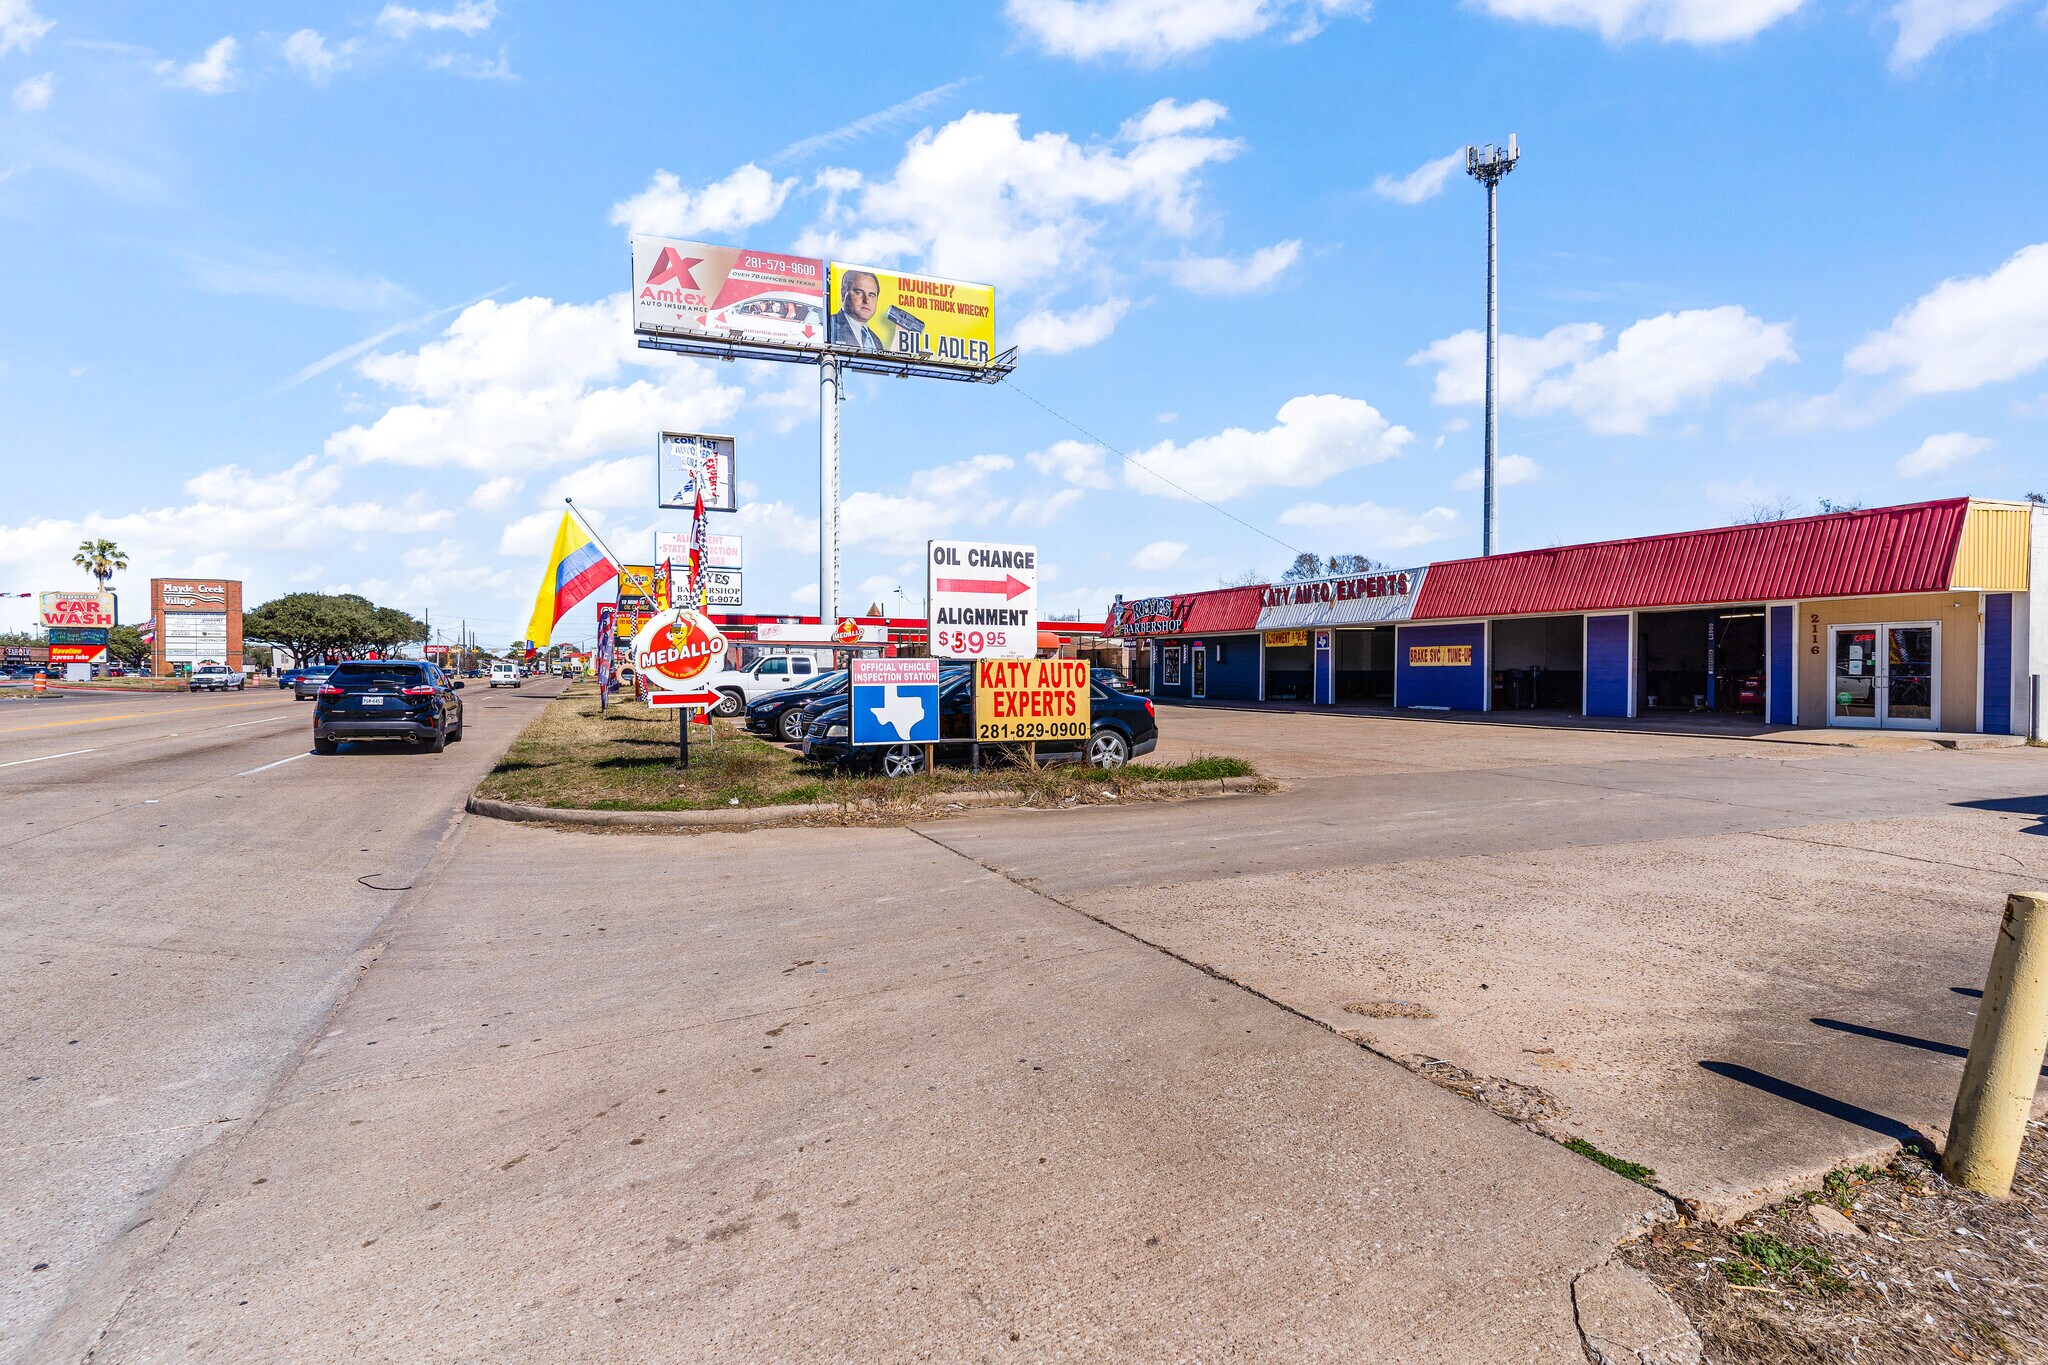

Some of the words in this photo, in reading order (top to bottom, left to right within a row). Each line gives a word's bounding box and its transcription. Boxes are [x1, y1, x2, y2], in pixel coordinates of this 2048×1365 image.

[745, 256, 816, 277] 281-579-9600
[760, 274, 787, 283] OFFICES
[795, 279, 816, 287] TEXAS
[898, 277, 955, 298] INJURED?
[640, 286, 708, 307] Amtex
[640, 300, 662, 308] AUTO
[664, 302, 708, 313] INSURANCE
[898, 293, 915, 308] CAR
[917, 297, 928, 309] OR
[929, 298, 955, 314] TRUCK
[957, 303, 989, 318] WRECK?
[898, 330, 931, 354] BILL
[938, 335, 989, 362] ADLER
[676, 534, 724, 545] ALIENT
[662, 544, 686, 554] STATE
[675, 555, 689, 564] OIL
[934, 546, 961, 566] OIL
[968, 548, 1034, 570] CHANGE
[163, 584, 194, 594] Mayde
[198, 584, 225, 594] Creek
[1258, 586, 1290, 607] KATY
[1294, 582, 1330, 605] AUTO
[1337, 573, 1408, 601] EXPERTS
[56, 602, 100, 612] CAR
[164, 597, 196, 608] Village
[1132, 597, 1172, 621] REYES
[44, 614, 112, 625] WASH
[936, 608, 1028, 626] ALIGNMENT
[833, 629, 864, 638] MEDALLO
[1124, 620, 1182, 634] BARBERSHOP
[1854, 634, 1876, 642] OPEN
[640, 637, 724, 669] MEDALLO
[1410, 648, 1428, 662] BRAKE
[1430, 648, 1441, 662] SVC
[1448, 648, 1472, 662] TUNE-UP
[860, 662, 896, 671] OFFICIAL
[898, 662, 931, 671] VEHICLE
[854, 672, 902, 682] INSPECTION
[904, 672, 936, 682] STATION
[980, 662, 1032, 688] KATY
[1038, 662, 1086, 688] AUTO
[993, 690, 1076, 718] EXPERTS
[980, 722, 1087, 739] 281-829-0900
